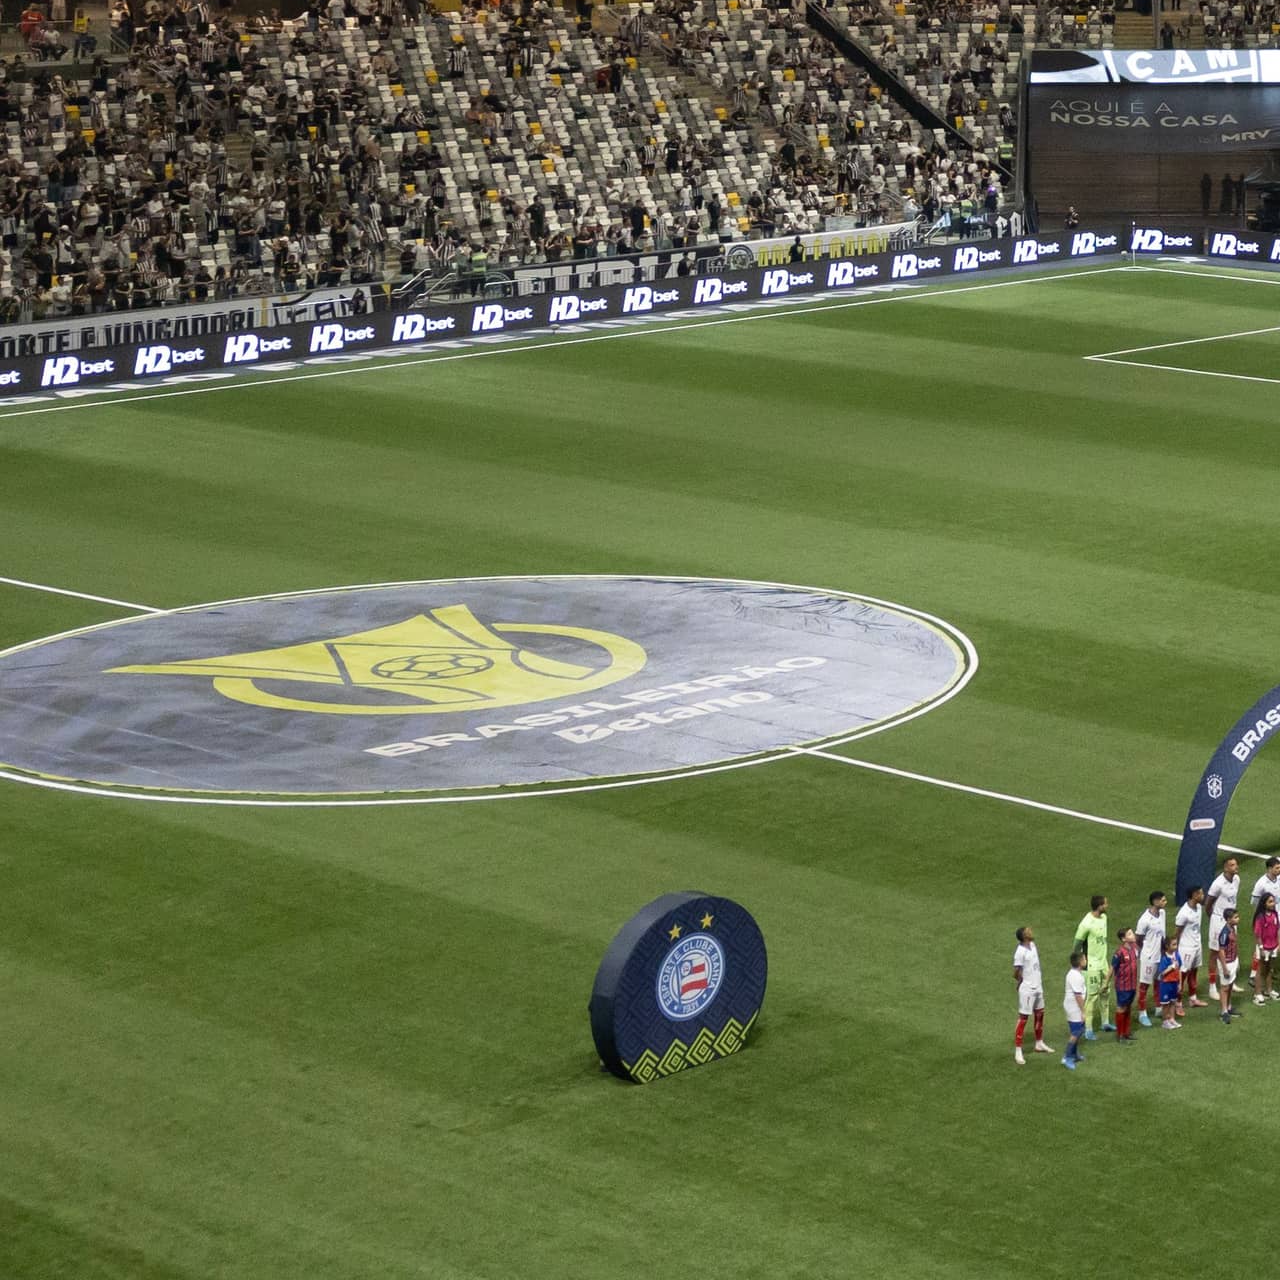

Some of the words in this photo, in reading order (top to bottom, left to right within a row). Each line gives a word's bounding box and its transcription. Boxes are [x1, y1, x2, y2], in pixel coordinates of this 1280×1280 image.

[1126, 49, 1239, 80] CAM
[1050, 100, 1119, 114] AQUI
[1130, 98, 1145, 114] É
[1154, 101, 1173, 114] A
[1050, 111, 1151, 128] NOSSA
[1159, 113, 1239, 128] CASA
[1220, 128, 1272, 144] MRV
[1131, 229, 1193, 253] H2bet
[1211, 233, 1259, 256] H2bet
[41, 356, 115, 387] H2bet
[133, 346, 205, 375] H2bet
[224, 335, 292, 363] H2bet
[310, 324, 375, 352] H2bet
[392, 314, 455, 341] H2bet
[472, 304, 533, 332] H2bet
[549, 295, 607, 321] H2bet
[622, 286, 679, 312] H2bet
[694, 278, 747, 303] H2bet
[762, 270, 814, 295] H2bet
[827, 262, 878, 286] H2bet
[892, 254, 941, 278] H2bet
[954, 247, 1001, 270] H2bet
[1013, 240, 1059, 263] H2bet
[1071, 232, 1117, 256] H2bet
[363, 656, 829, 758] BRASILEIRÃO
[553, 689, 776, 745] Betano
[683, 938, 714, 954] CLUBE
[709, 951, 721, 989] BAHIA
